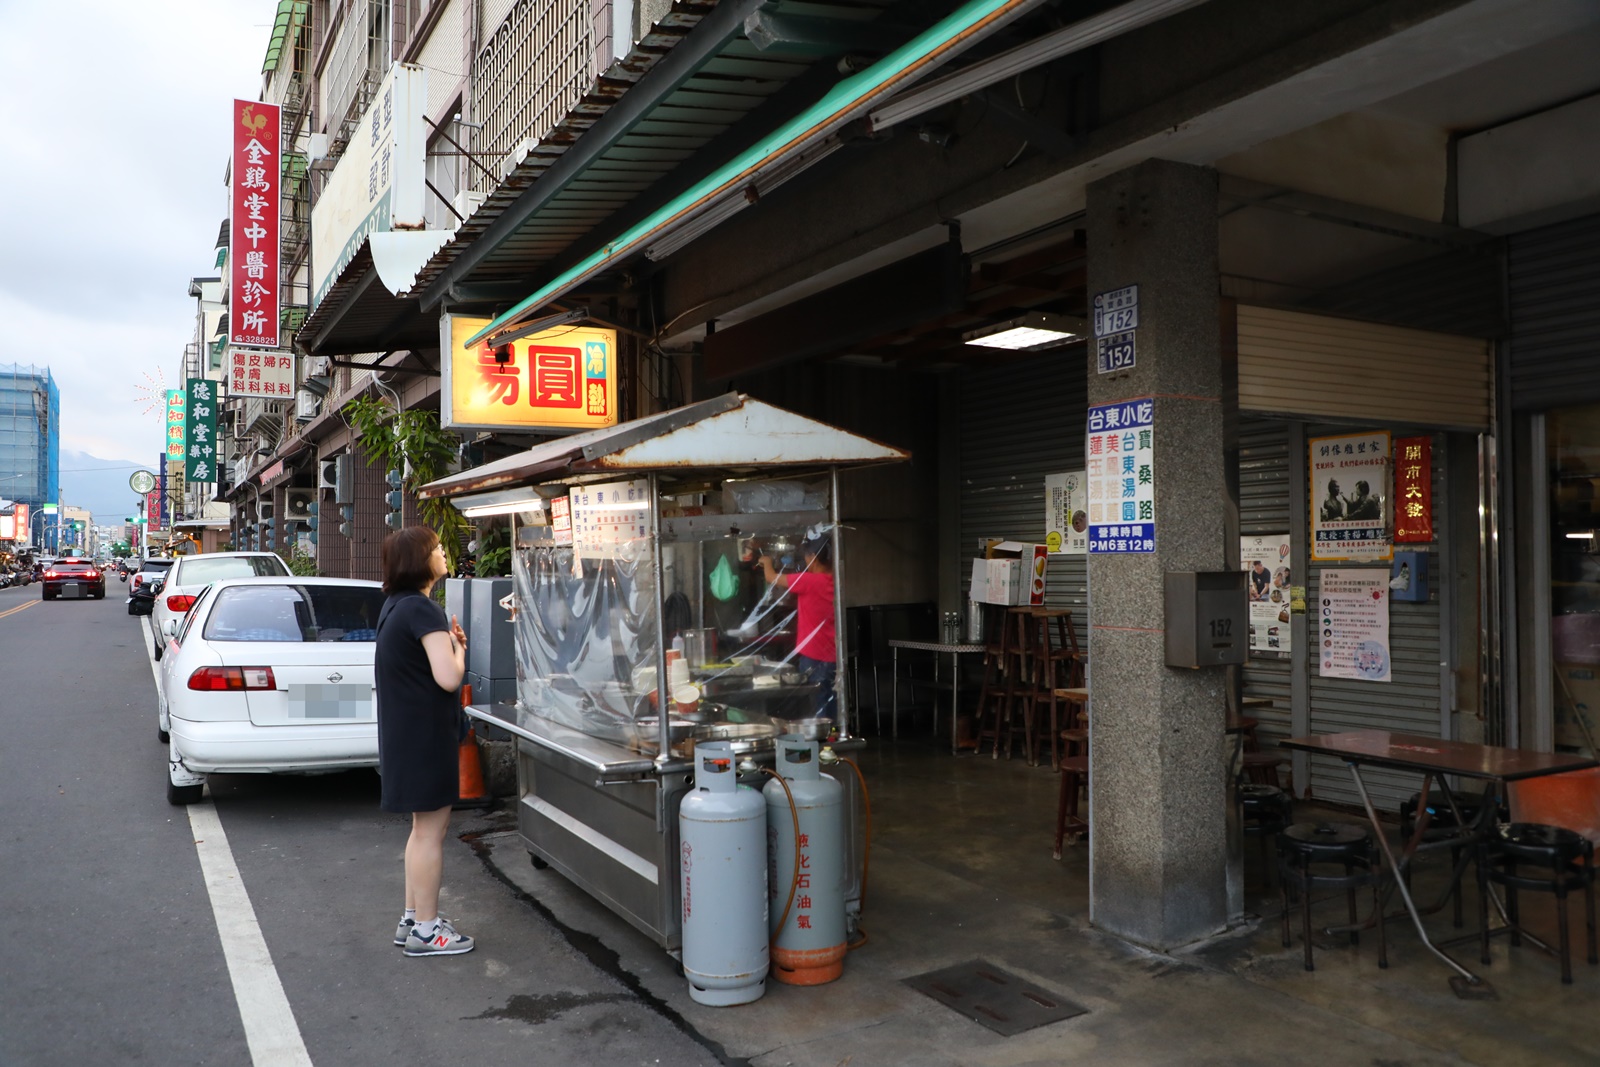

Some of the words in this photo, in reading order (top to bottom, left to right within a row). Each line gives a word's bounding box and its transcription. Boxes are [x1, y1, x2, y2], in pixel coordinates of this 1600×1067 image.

[1109, 310, 1133, 332] 152
[1108, 345, 1132, 368] 152
[1089, 402, 1153, 431] 台東小吃
[1122, 431, 1136, 522] 台東湯圓
[1138, 429, 1152, 521] 寶桑路
[1404, 445, 1423, 518] 開市大發
[1098, 525, 1143, 538] 營業時間
[1090, 538, 1154, 552] PM6至12時
[1209, 619, 1232, 637] 152
